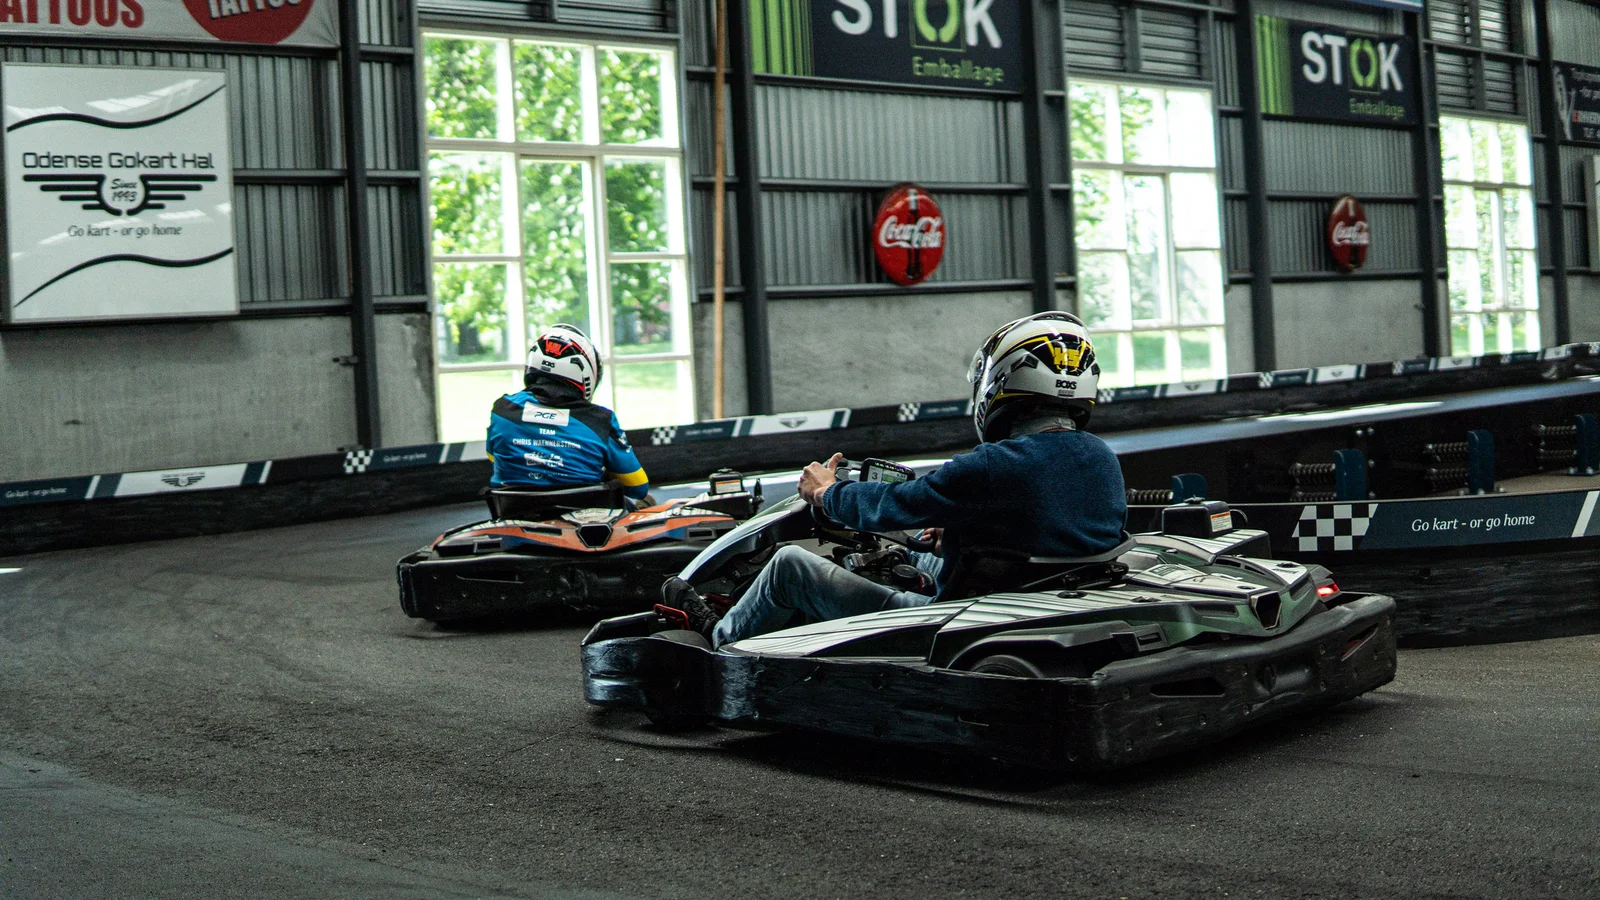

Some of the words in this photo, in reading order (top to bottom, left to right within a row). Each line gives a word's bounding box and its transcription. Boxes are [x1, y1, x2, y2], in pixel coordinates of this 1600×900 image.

[1301, 31, 1403, 91] STOK
[912, 56, 1004, 86] Emballage
[23, 151, 102, 168] Odense
[108, 151, 177, 168] Gokart
[182, 152, 214, 169] Hal
[68, 225, 84, 236] Go
[87, 224, 110, 236] kart
[121, 227, 133, 236] or
[136, 226, 150, 238] go
[152, 224, 182, 235] home
[879, 215, 942, 248] Coca-Cola
[1055, 379, 1077, 390] BOXS
[534, 411, 557, 420] PGE
[1411, 519, 1429, 531] Go
[1432, 518, 1458, 530] kart
[1470, 519, 1483, 528] or
[1486, 518, 1501, 531] go
[1503, 513, 1535, 527] home
